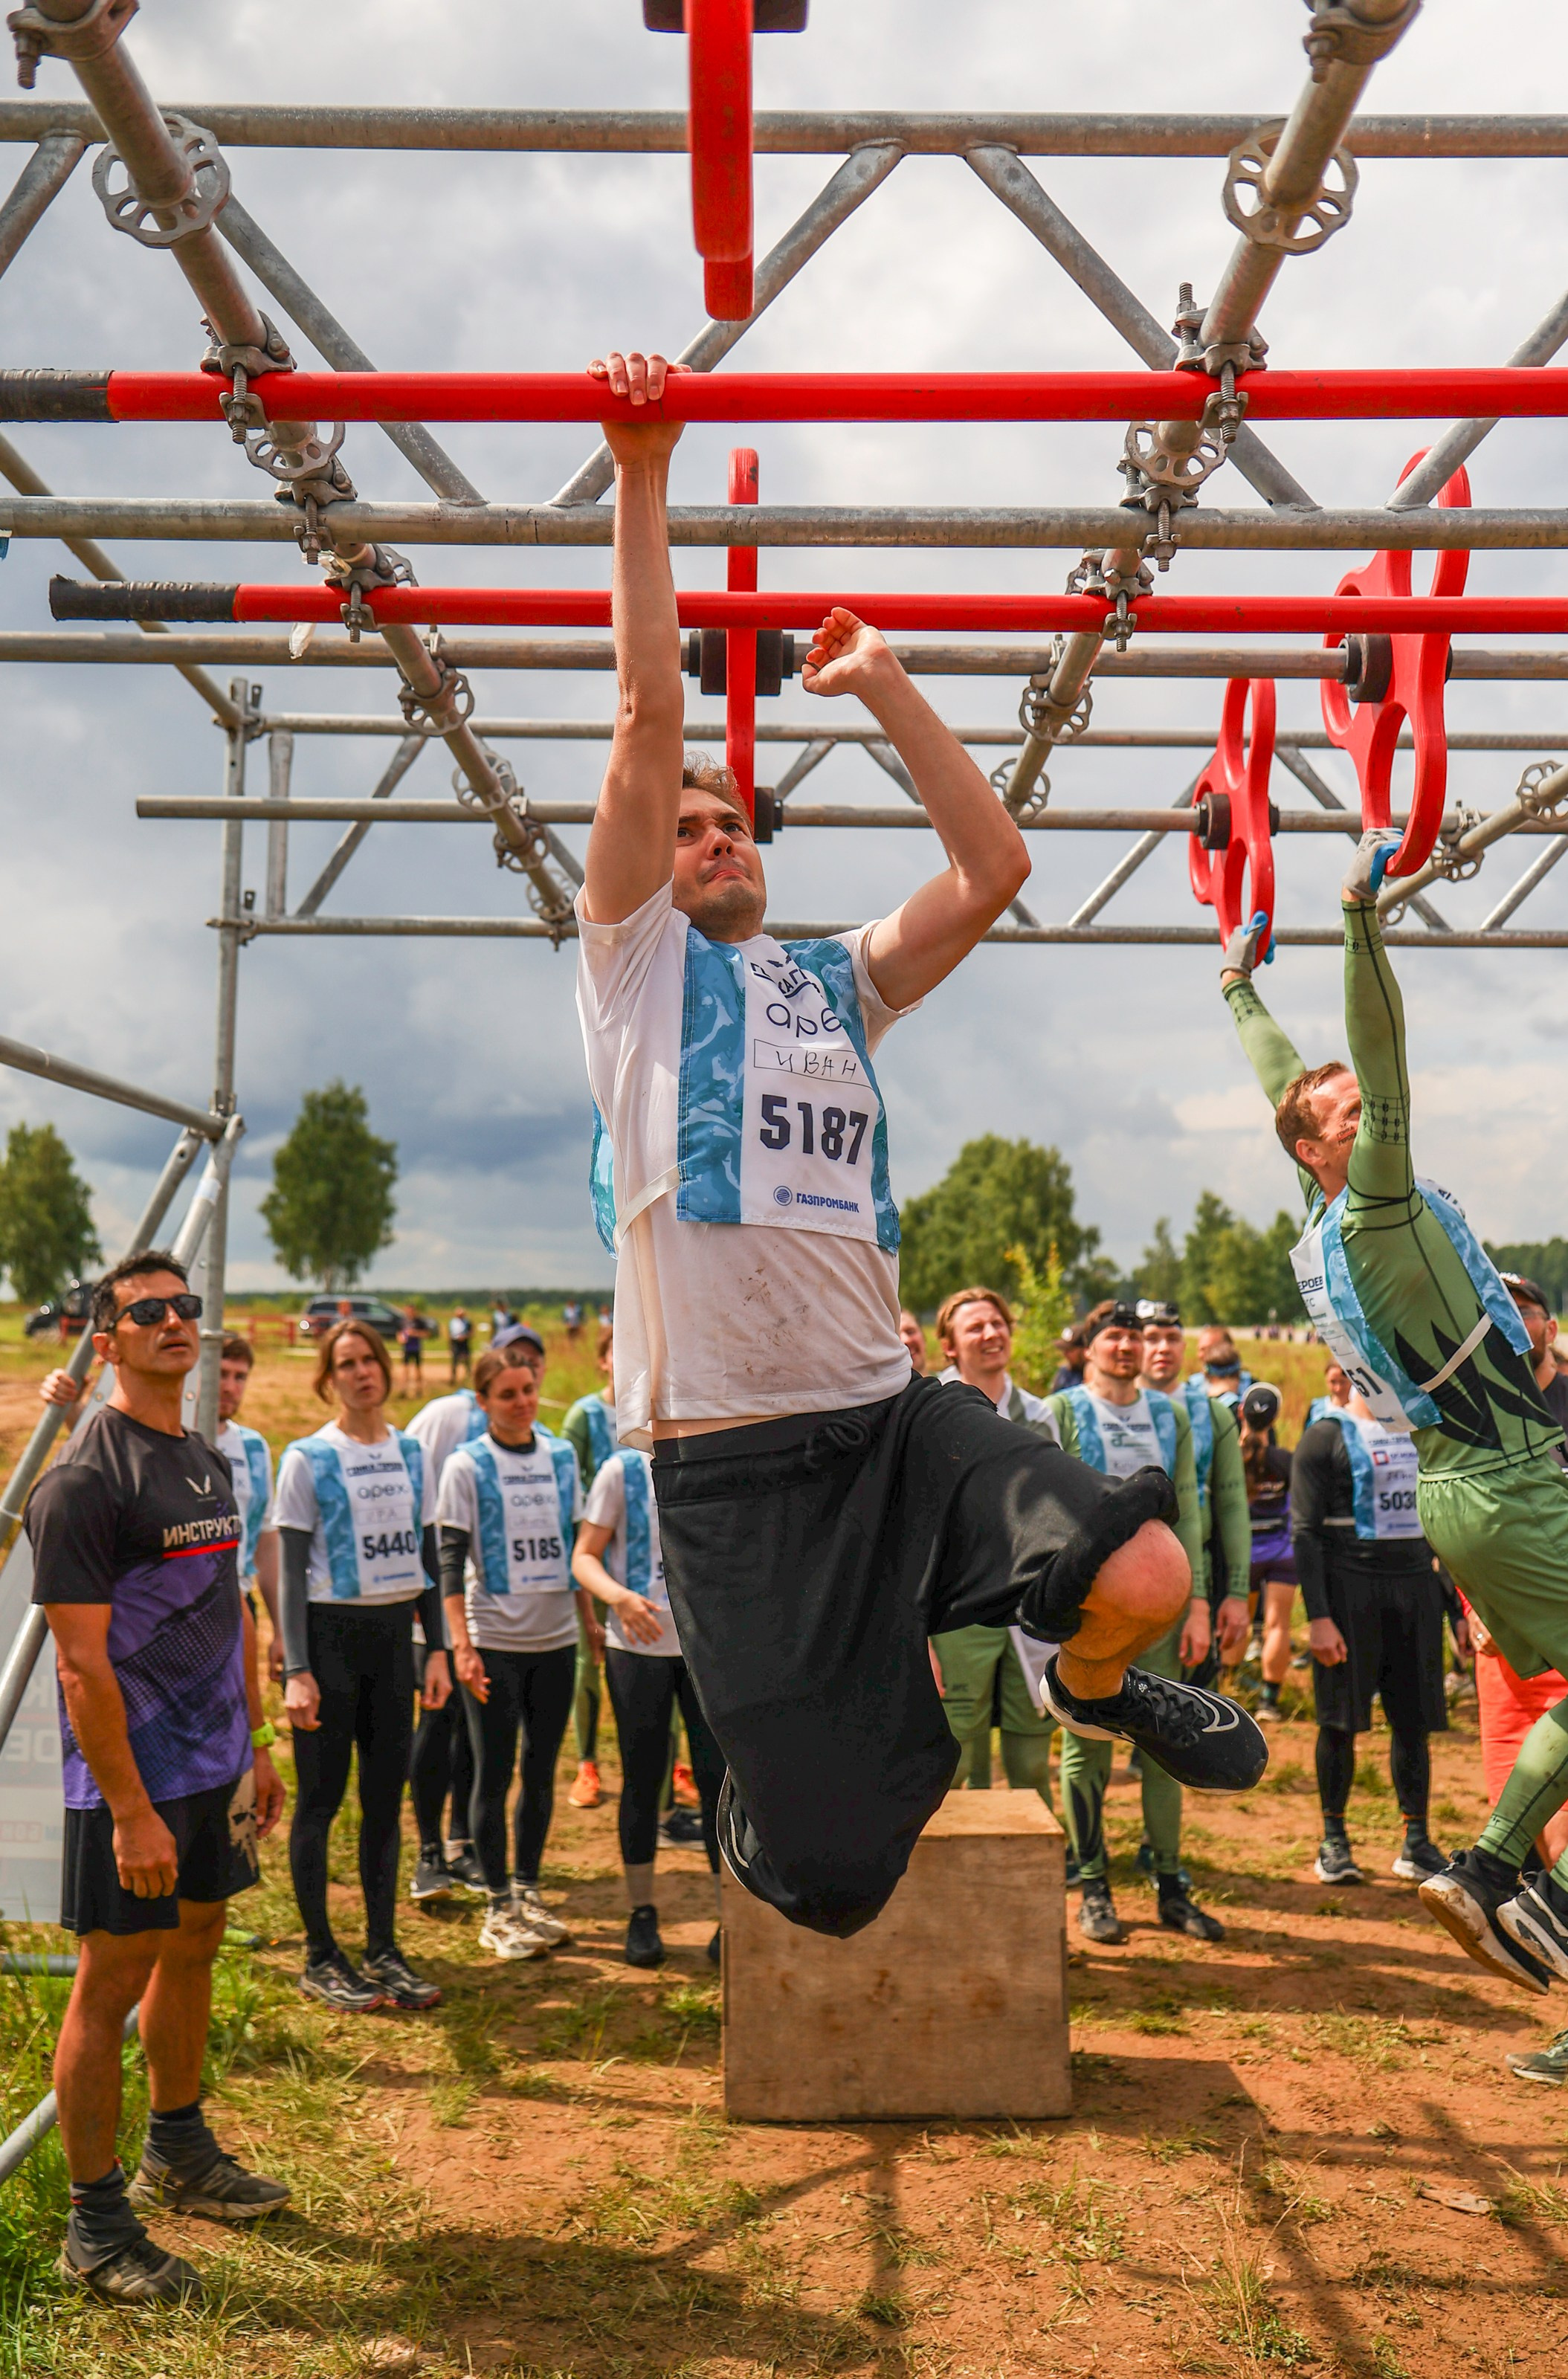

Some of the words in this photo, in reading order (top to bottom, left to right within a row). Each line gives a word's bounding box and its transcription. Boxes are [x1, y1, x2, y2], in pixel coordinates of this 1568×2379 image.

[760, 1094, 868, 1165] 5187
[796, 1192, 859, 1213] ГАЗПРОМБАНК
[1380, 1490, 1416, 1511] 503
[163, 1514, 241, 1547] ИНСТРУКТ
[362, 1530, 416, 1560] 5440
[513, 1537, 561, 1561] 5185
